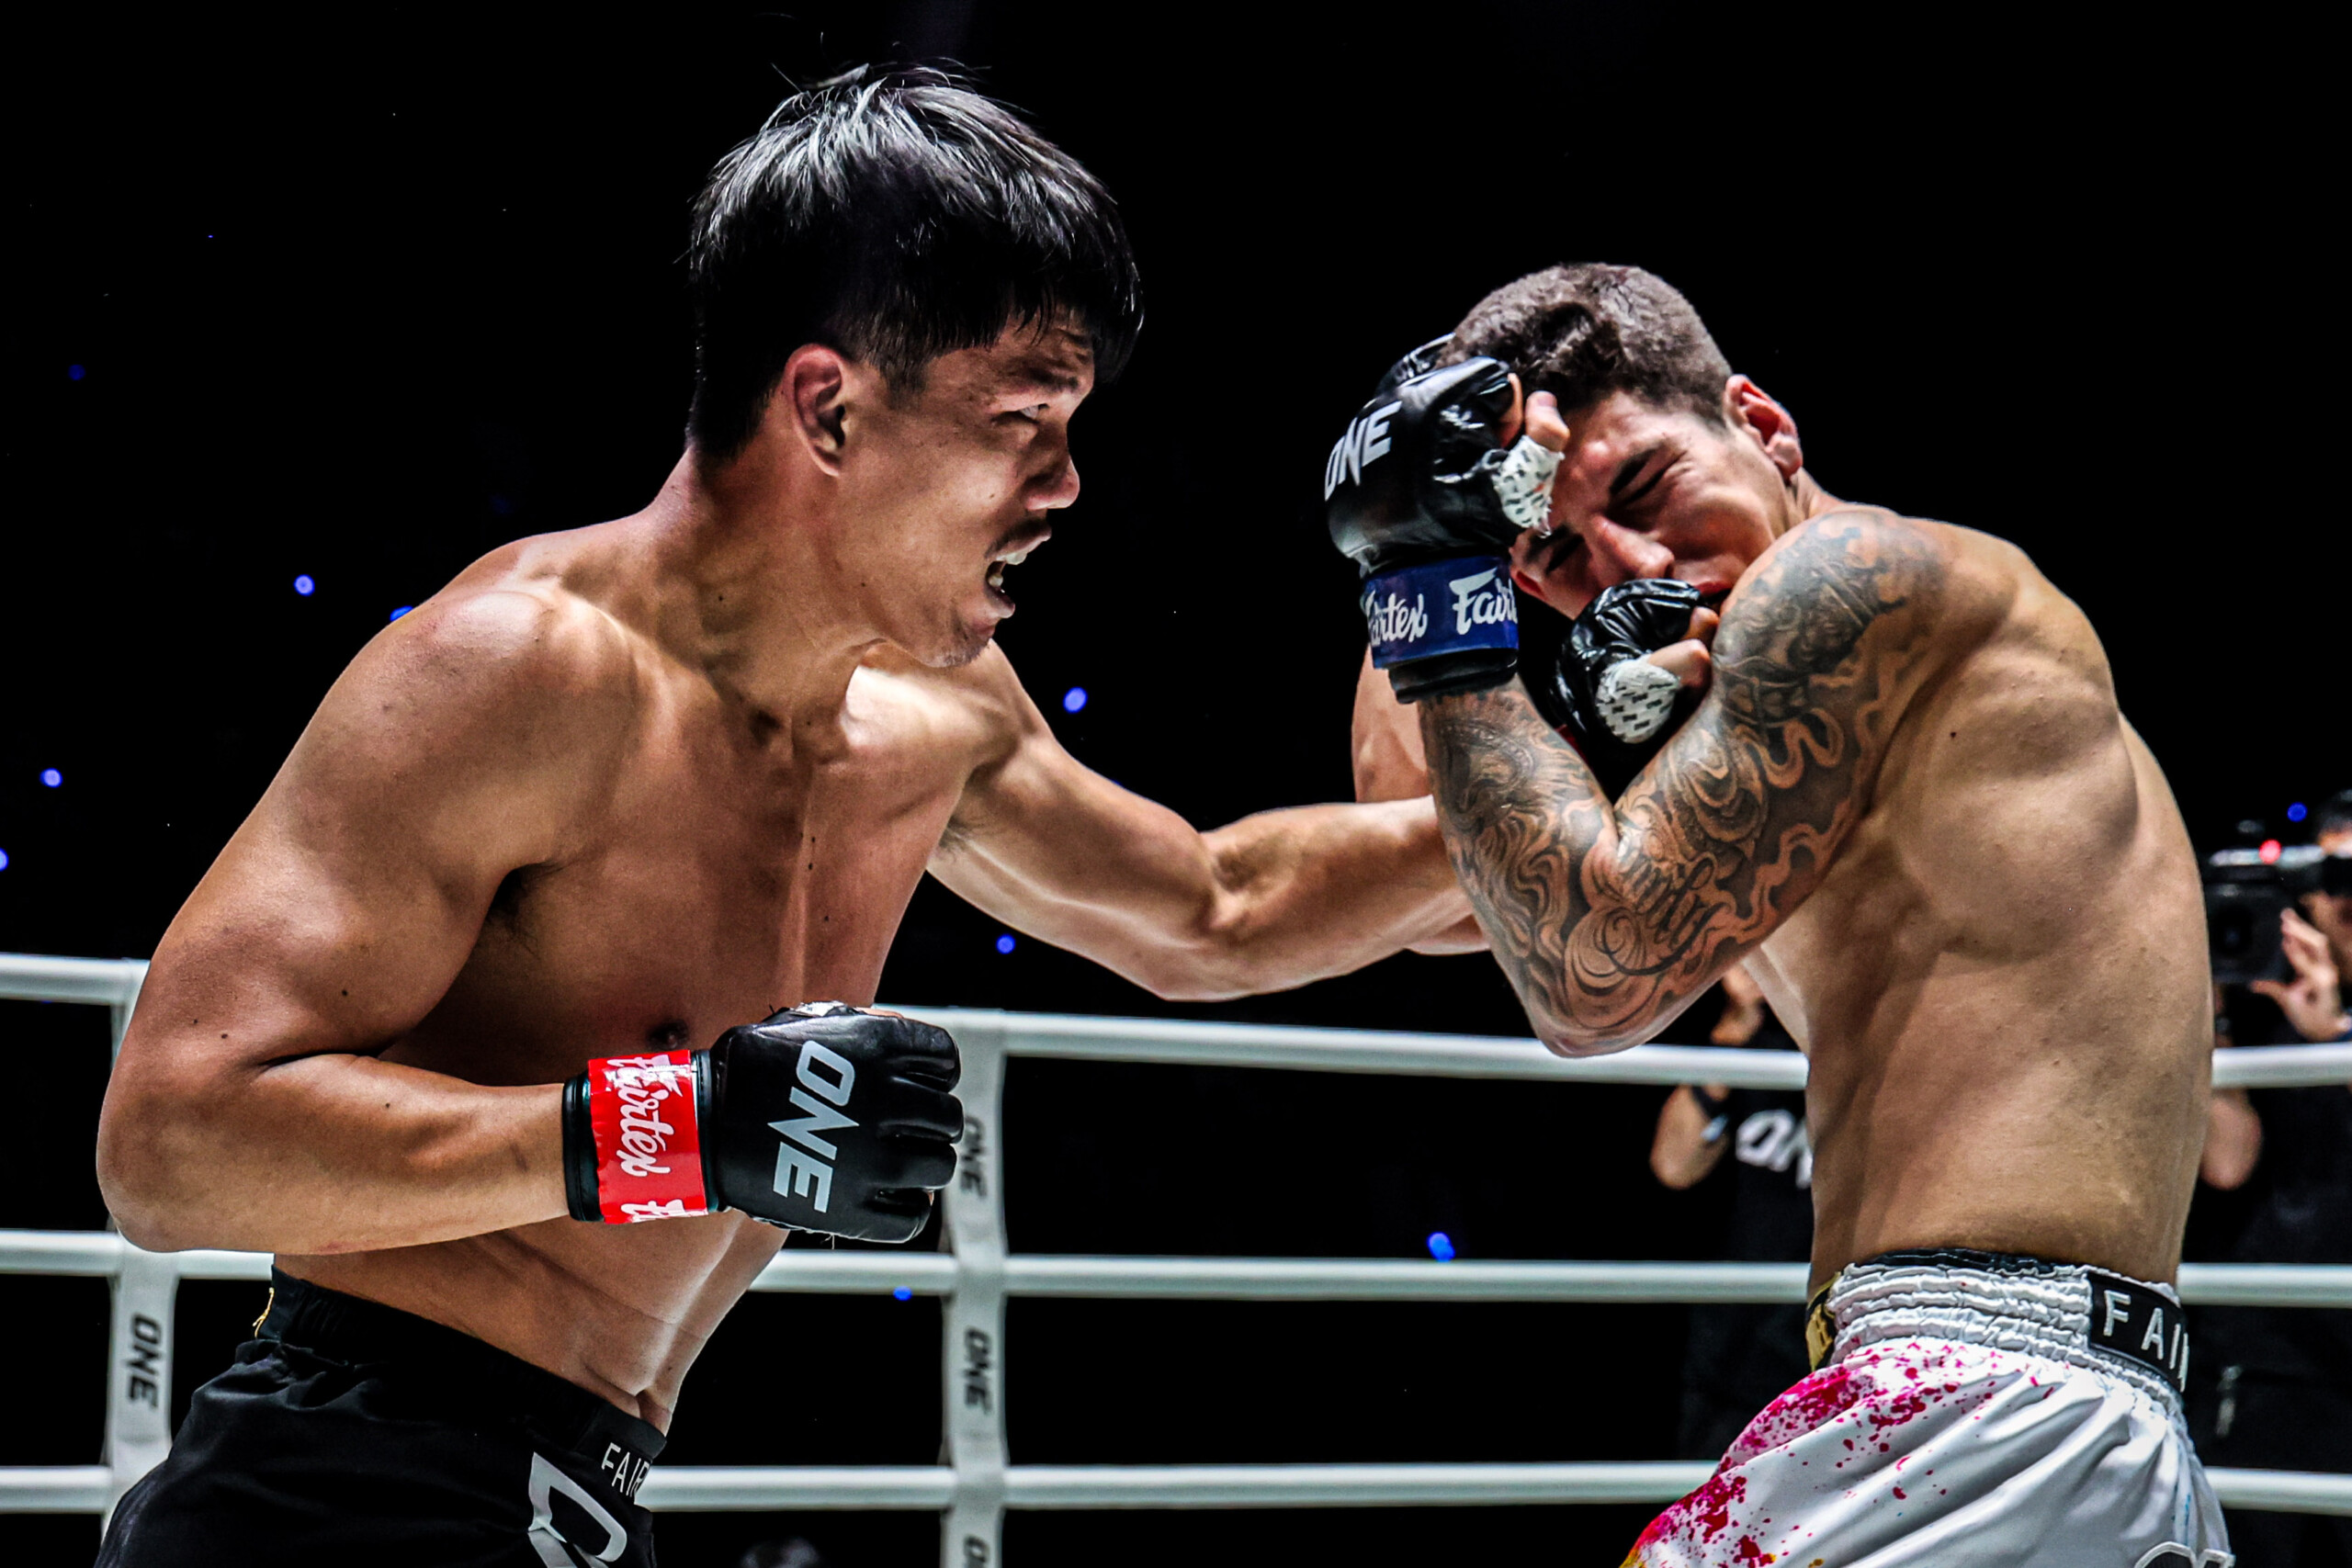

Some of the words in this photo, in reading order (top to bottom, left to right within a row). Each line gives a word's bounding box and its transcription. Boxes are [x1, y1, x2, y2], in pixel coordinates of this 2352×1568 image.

[1324, 400, 1403, 502] ONE
[606, 1054, 684, 1178] Fairtex
[767, 1040, 860, 1213] ONE
[1736, 1110, 1814, 1190] ON
[129, 1314, 161, 1408] ONE
[964, 1327, 991, 1414] ONE
